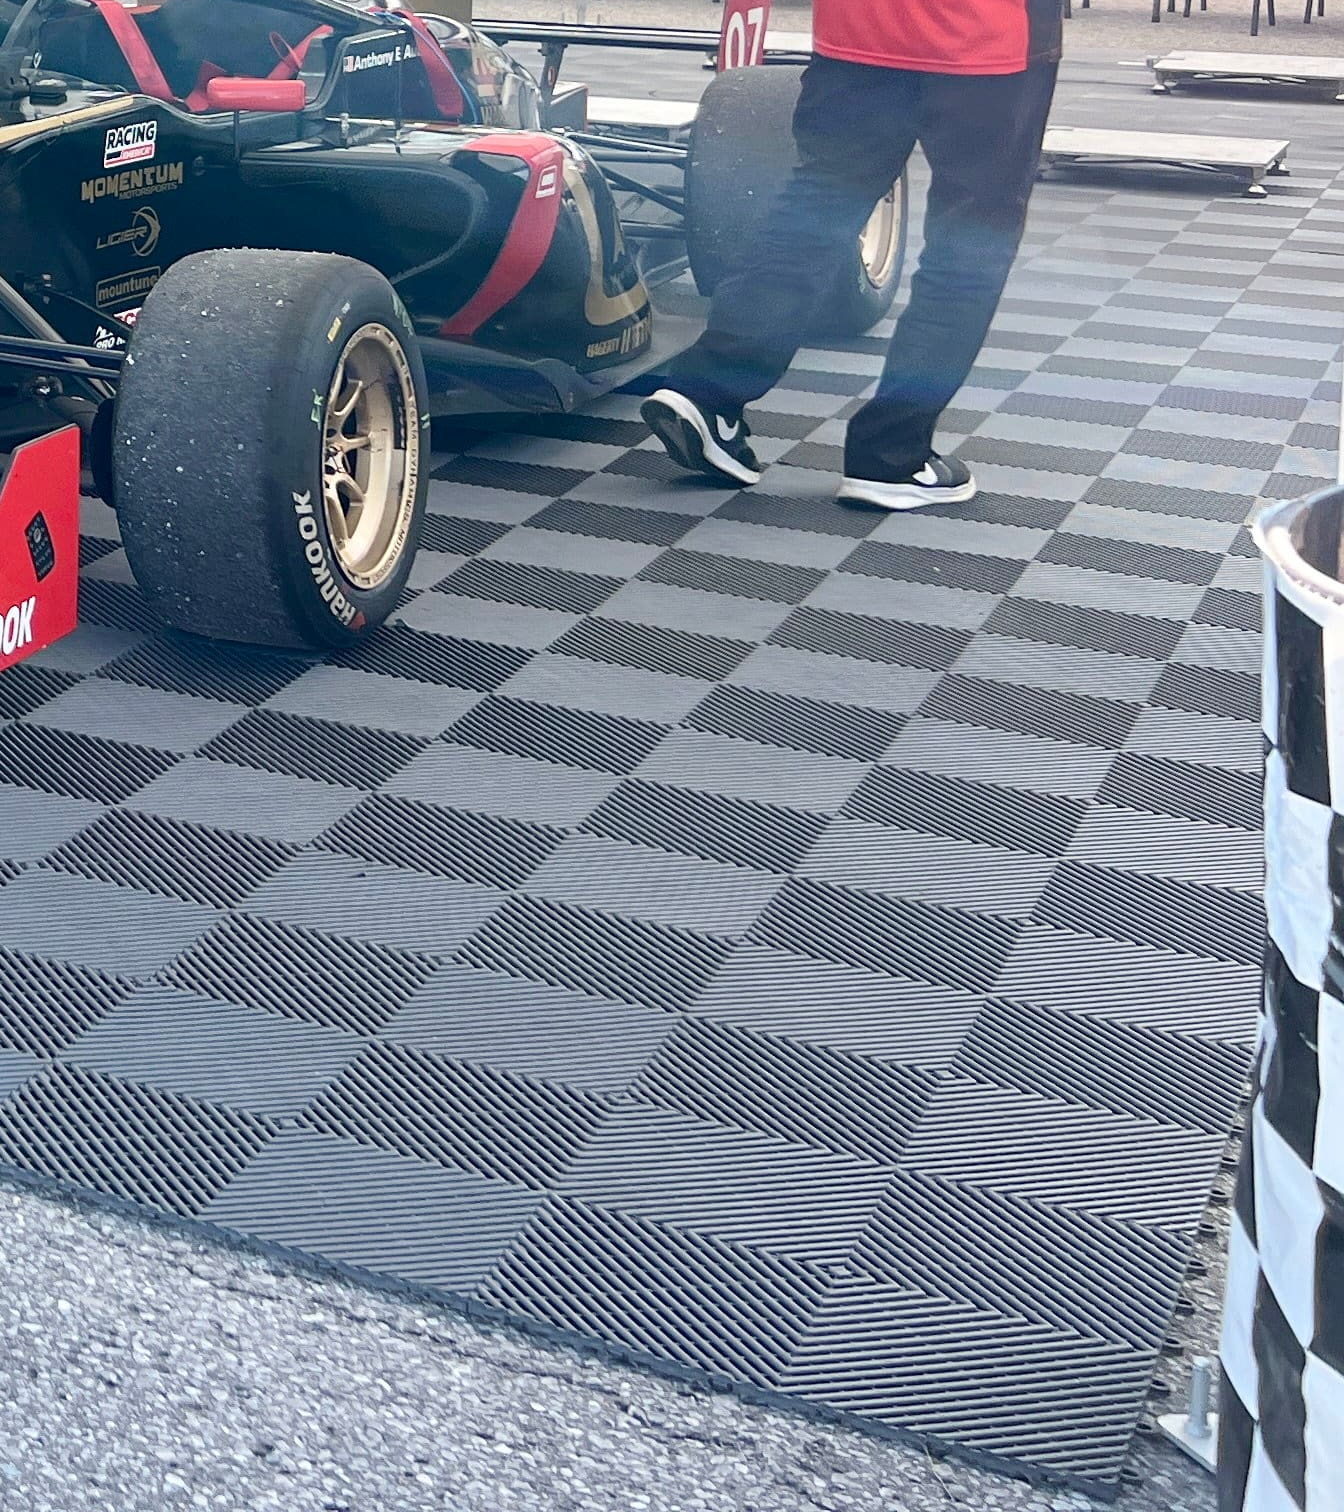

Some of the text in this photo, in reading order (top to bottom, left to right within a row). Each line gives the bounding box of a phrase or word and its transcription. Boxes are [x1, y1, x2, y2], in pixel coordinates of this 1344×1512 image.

[725, 7, 764, 69] 07
[353, 51, 394, 71] Anthony
[106, 122, 156, 149] RACING
[81, 162, 183, 203] MOMENTUM
[119, 182, 178, 200] MOTORSPORTS
[96, 225, 148, 249] LIGIER
[98, 274, 158, 302] mountune
